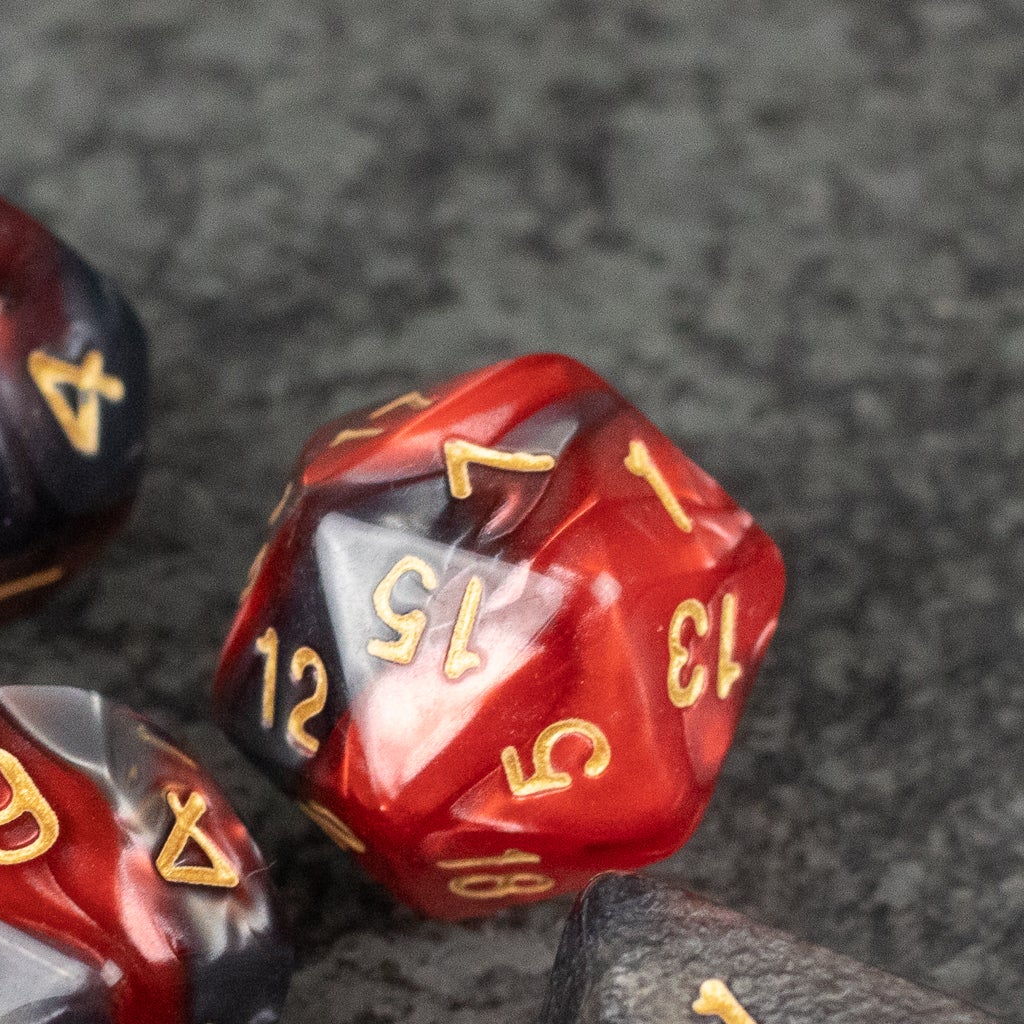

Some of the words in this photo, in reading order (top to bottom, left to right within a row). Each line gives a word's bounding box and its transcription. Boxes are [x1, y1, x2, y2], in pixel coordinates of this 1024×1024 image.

[27, 349, 125, 455] 4
[624, 440, 692, 532] 1
[366, 555, 483, 679] 15
[666, 593, 743, 709] 13
[256, 627, 328, 756] 12
[499, 718, 613, 797] 5
[155, 785, 241, 888] 4
[436, 847, 556, 899] 18
